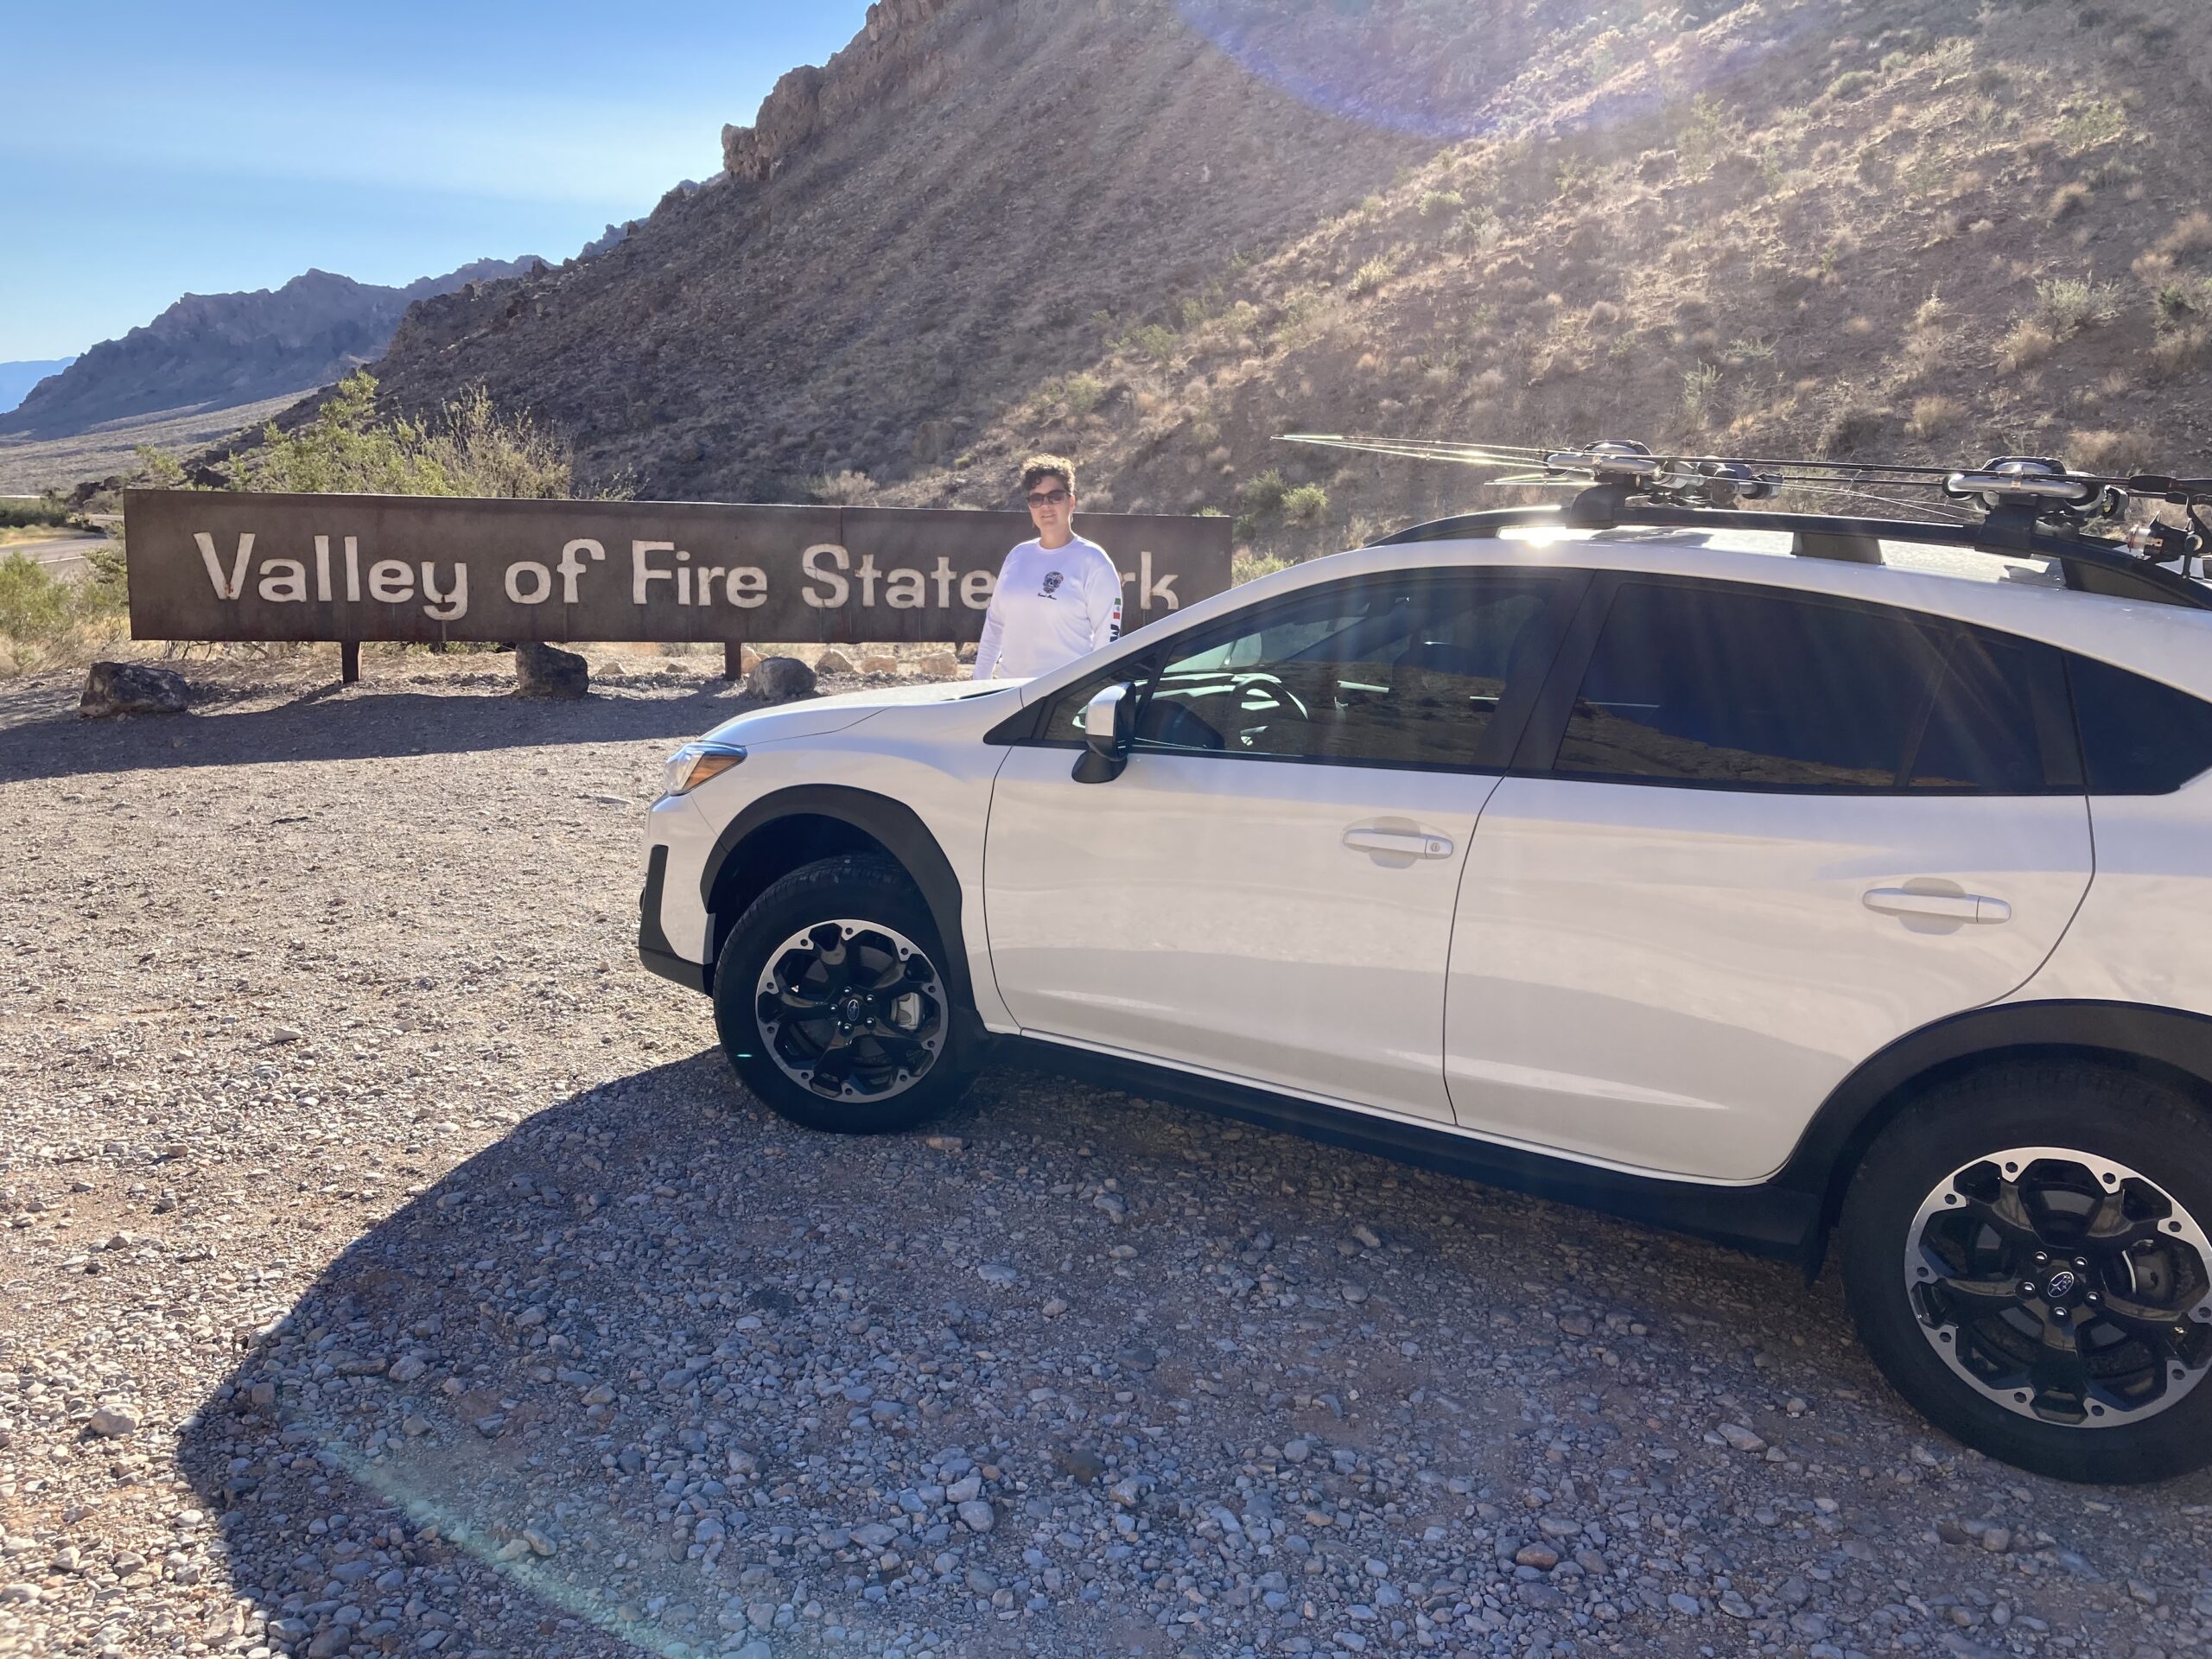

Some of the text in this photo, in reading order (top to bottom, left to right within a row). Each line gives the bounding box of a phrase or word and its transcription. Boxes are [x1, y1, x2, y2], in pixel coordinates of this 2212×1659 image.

[194, 532, 468, 620] Valley
[505, 538, 606, 605] of
[632, 540, 767, 608] Fire
[802, 543, 998, 610] State
